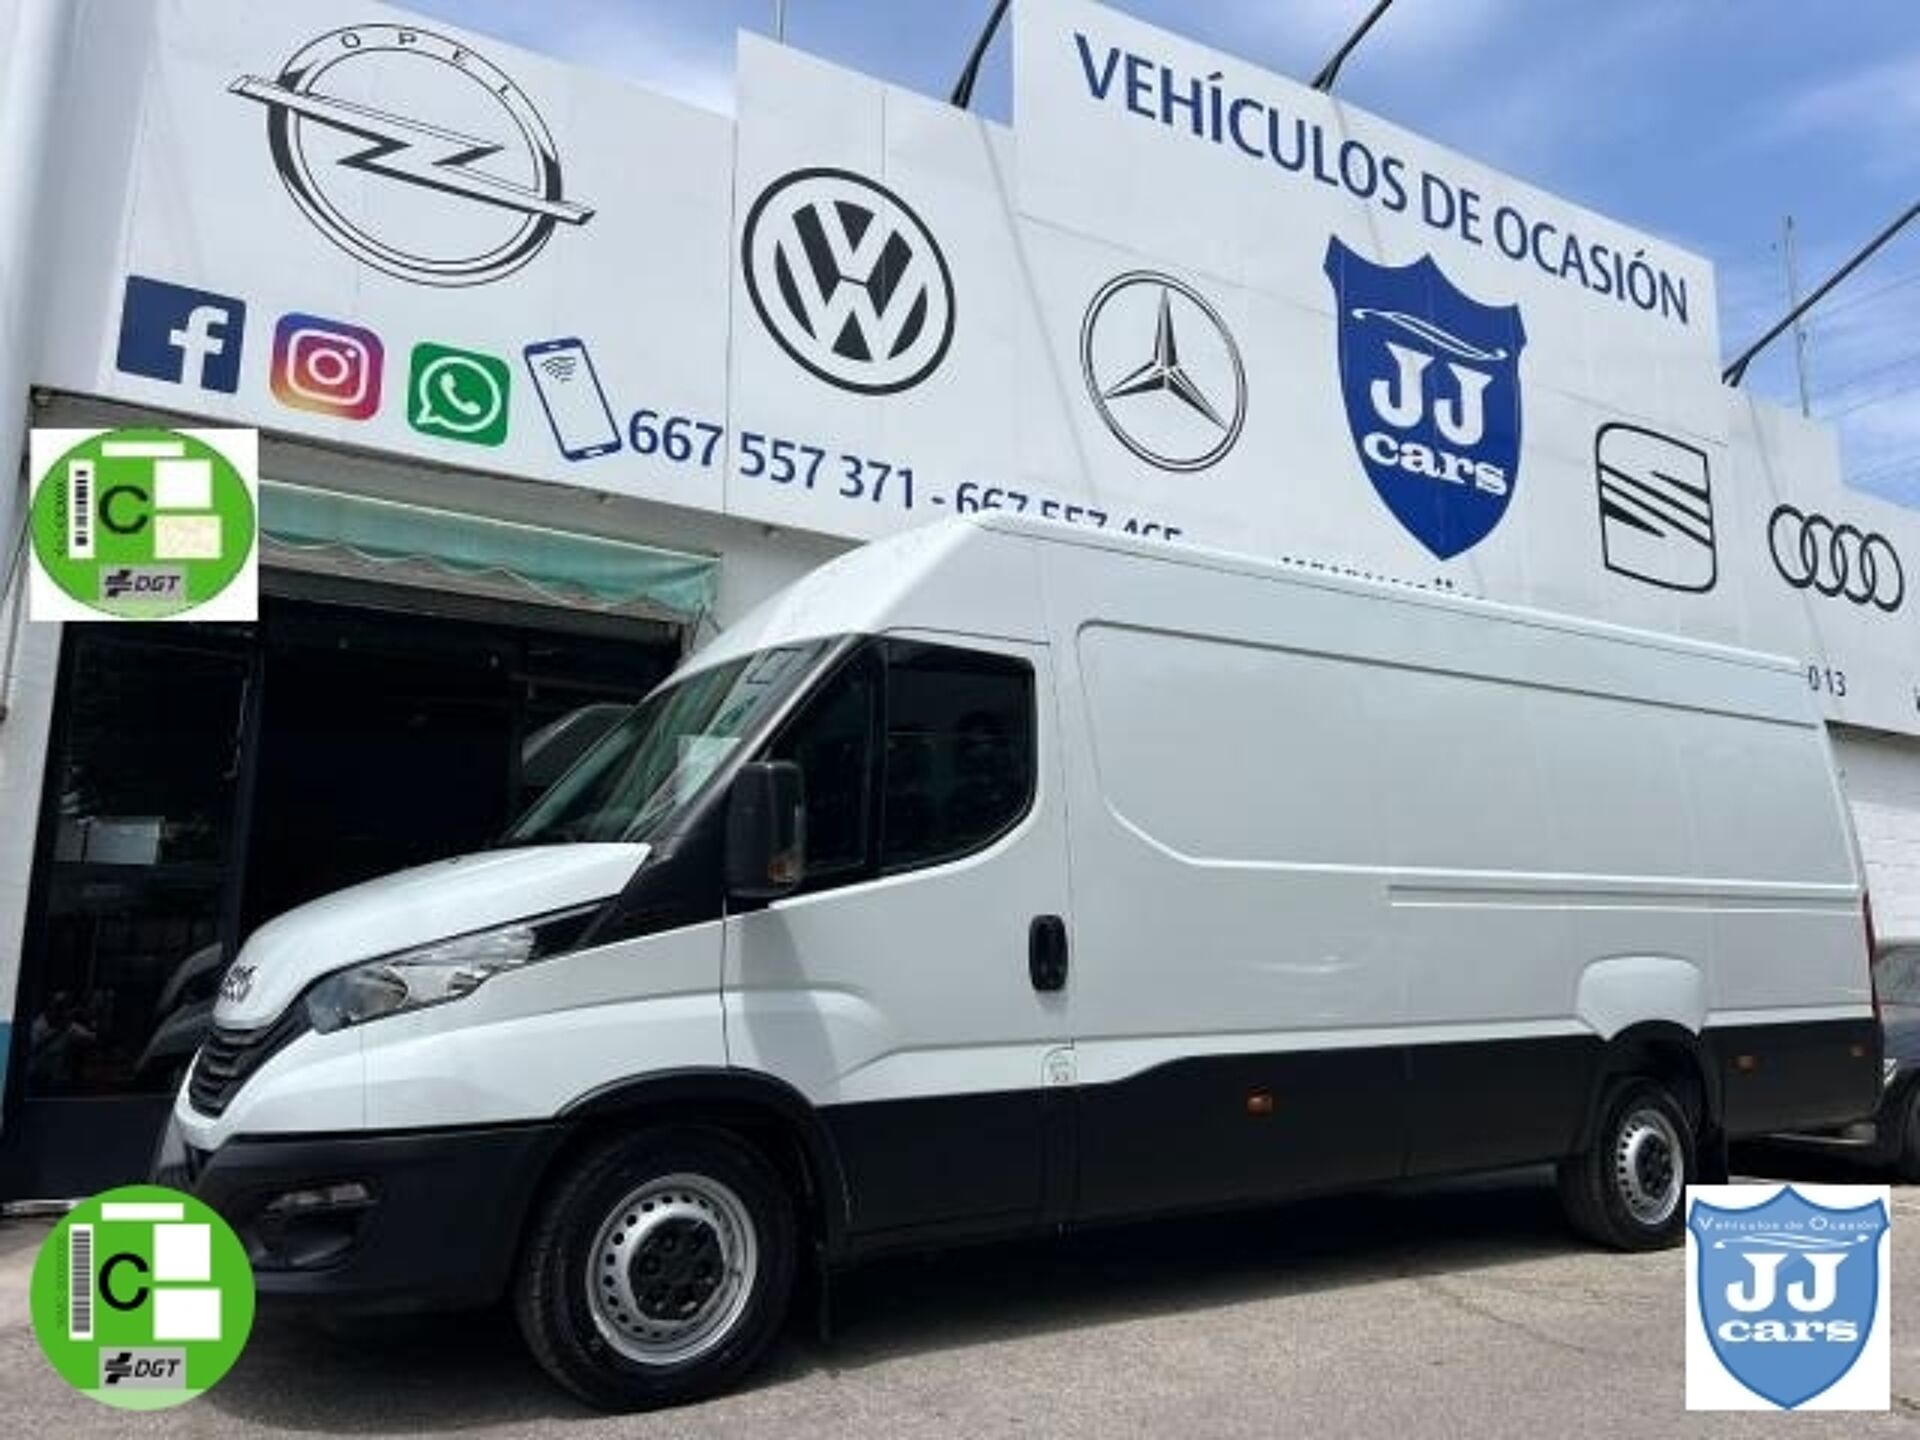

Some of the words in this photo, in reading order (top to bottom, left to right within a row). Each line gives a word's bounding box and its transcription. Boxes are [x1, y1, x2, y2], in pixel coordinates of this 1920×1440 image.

[341, 32, 511, 103] OPEL
[1074, 32, 1408, 213] VEHÍCULOS
[1421, 171, 1483, 246] DE
[1494, 206, 1688, 325] OCASIÓN
[1370, 341, 1494, 446] JJ
[628, 409, 724, 467] 667
[740, 430, 826, 490] 557
[839, 454, 914, 510] 371
[1363, 432, 1508, 496] cars
